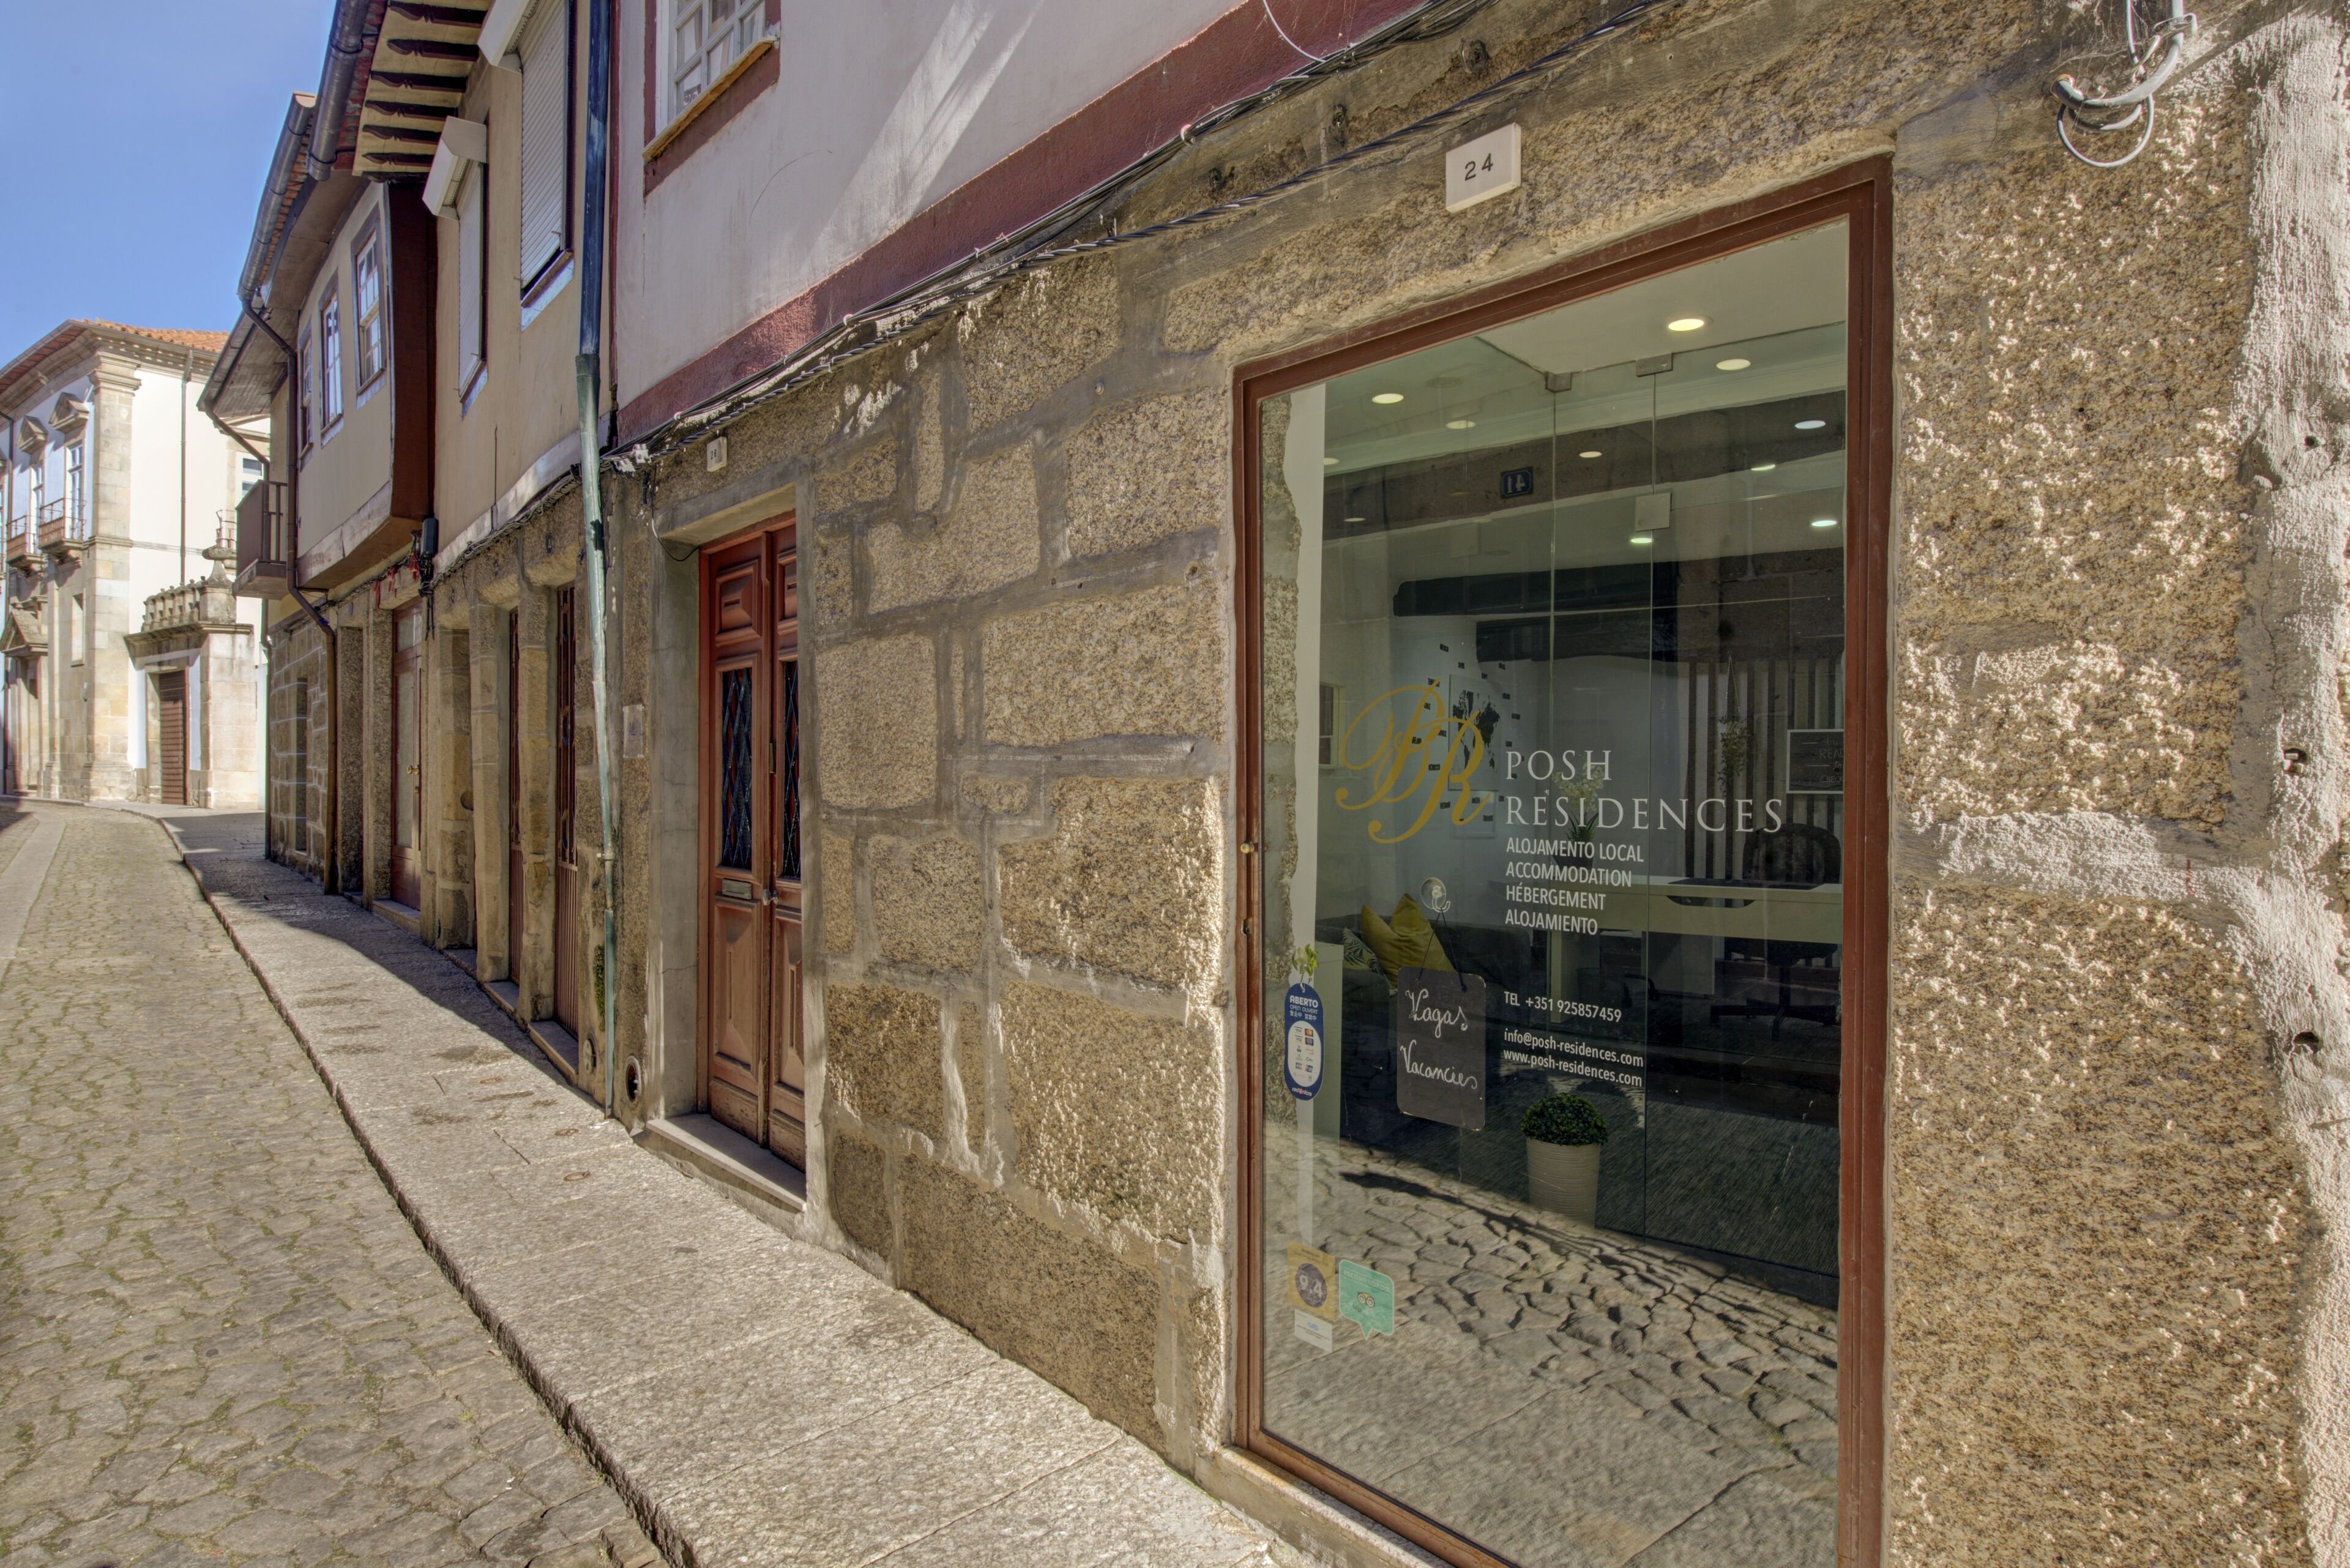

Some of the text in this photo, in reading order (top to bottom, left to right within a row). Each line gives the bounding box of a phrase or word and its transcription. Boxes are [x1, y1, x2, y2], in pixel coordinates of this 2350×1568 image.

[1464, 152, 1493, 181] 24
[1505, 750, 1612, 780] POSH
[1505, 796, 1782, 833] RESIDENCES
[1506, 837, 1644, 862] ALOJAMENTO LOCAL
[1505, 861, 1632, 887] ACCOMMODATION
[1506, 882, 1606, 911] HÉBERGEMENT
[1505, 909, 1598, 935] ALOJAMIENTO
[1289, 995, 1318, 1008] ABERTO
[1405, 988, 1468, 1038] Vagas
[1504, 991, 1622, 1023] TEL +351 925857459
[1504, 1028, 1644, 1067] info@posh-residences.com
[1400, 1039, 1478, 1089] Vacancies
[1503, 1049, 1643, 1087] www.posh-residences.com
[1299, 1274, 1324, 1298] 9.4
